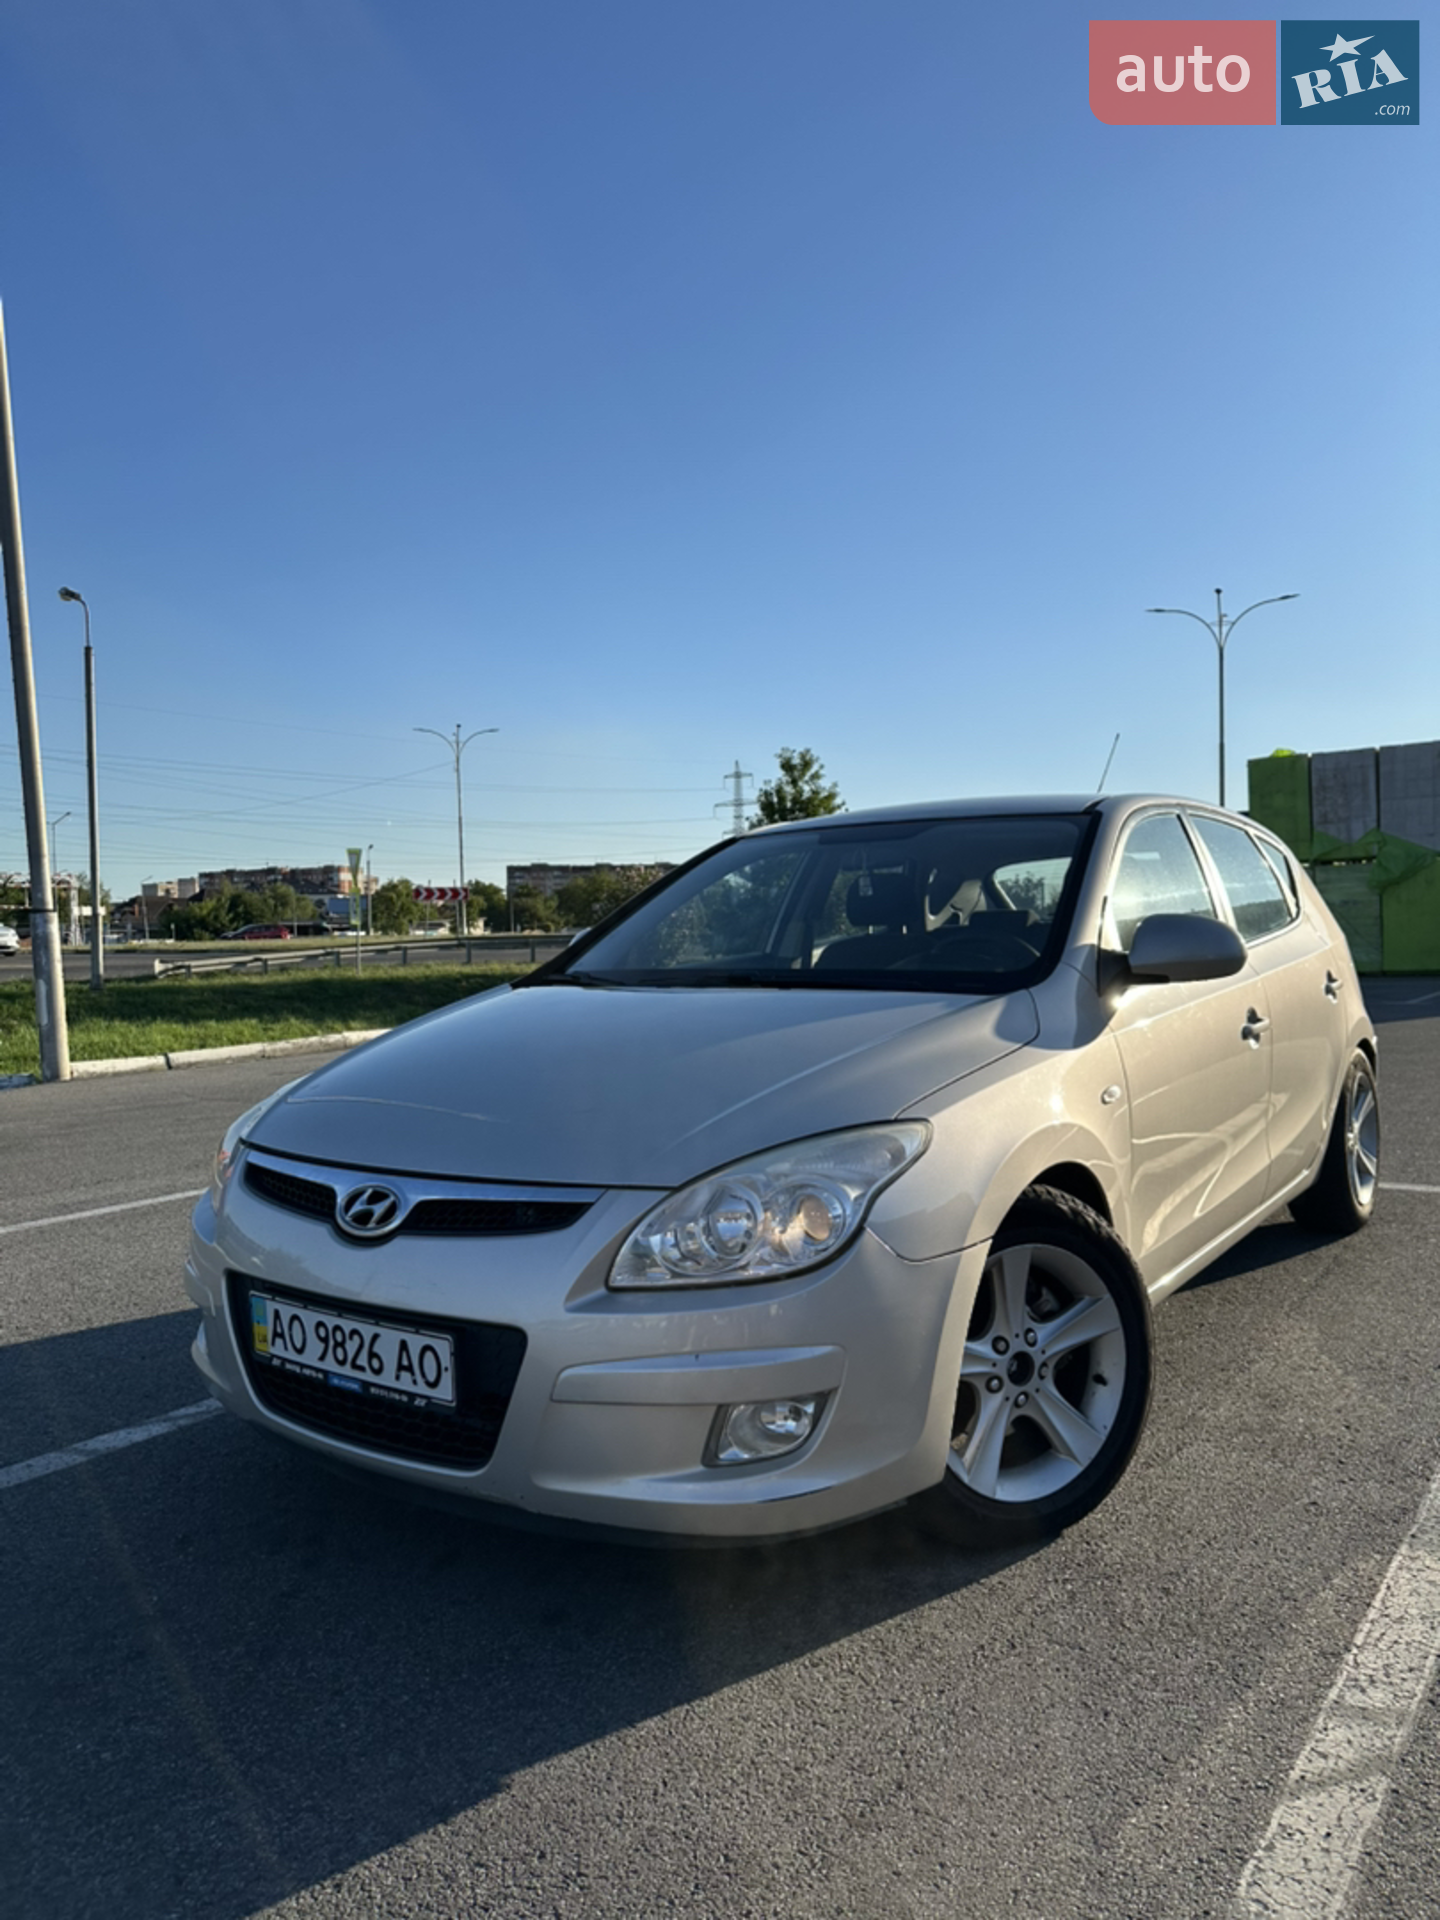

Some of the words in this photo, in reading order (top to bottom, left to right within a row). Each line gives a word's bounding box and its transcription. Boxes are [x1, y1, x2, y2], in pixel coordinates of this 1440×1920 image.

[271, 1308, 307, 1356] AO
[314, 1320, 384, 1376] 9826
[395, 1339, 442, 1389] AO
